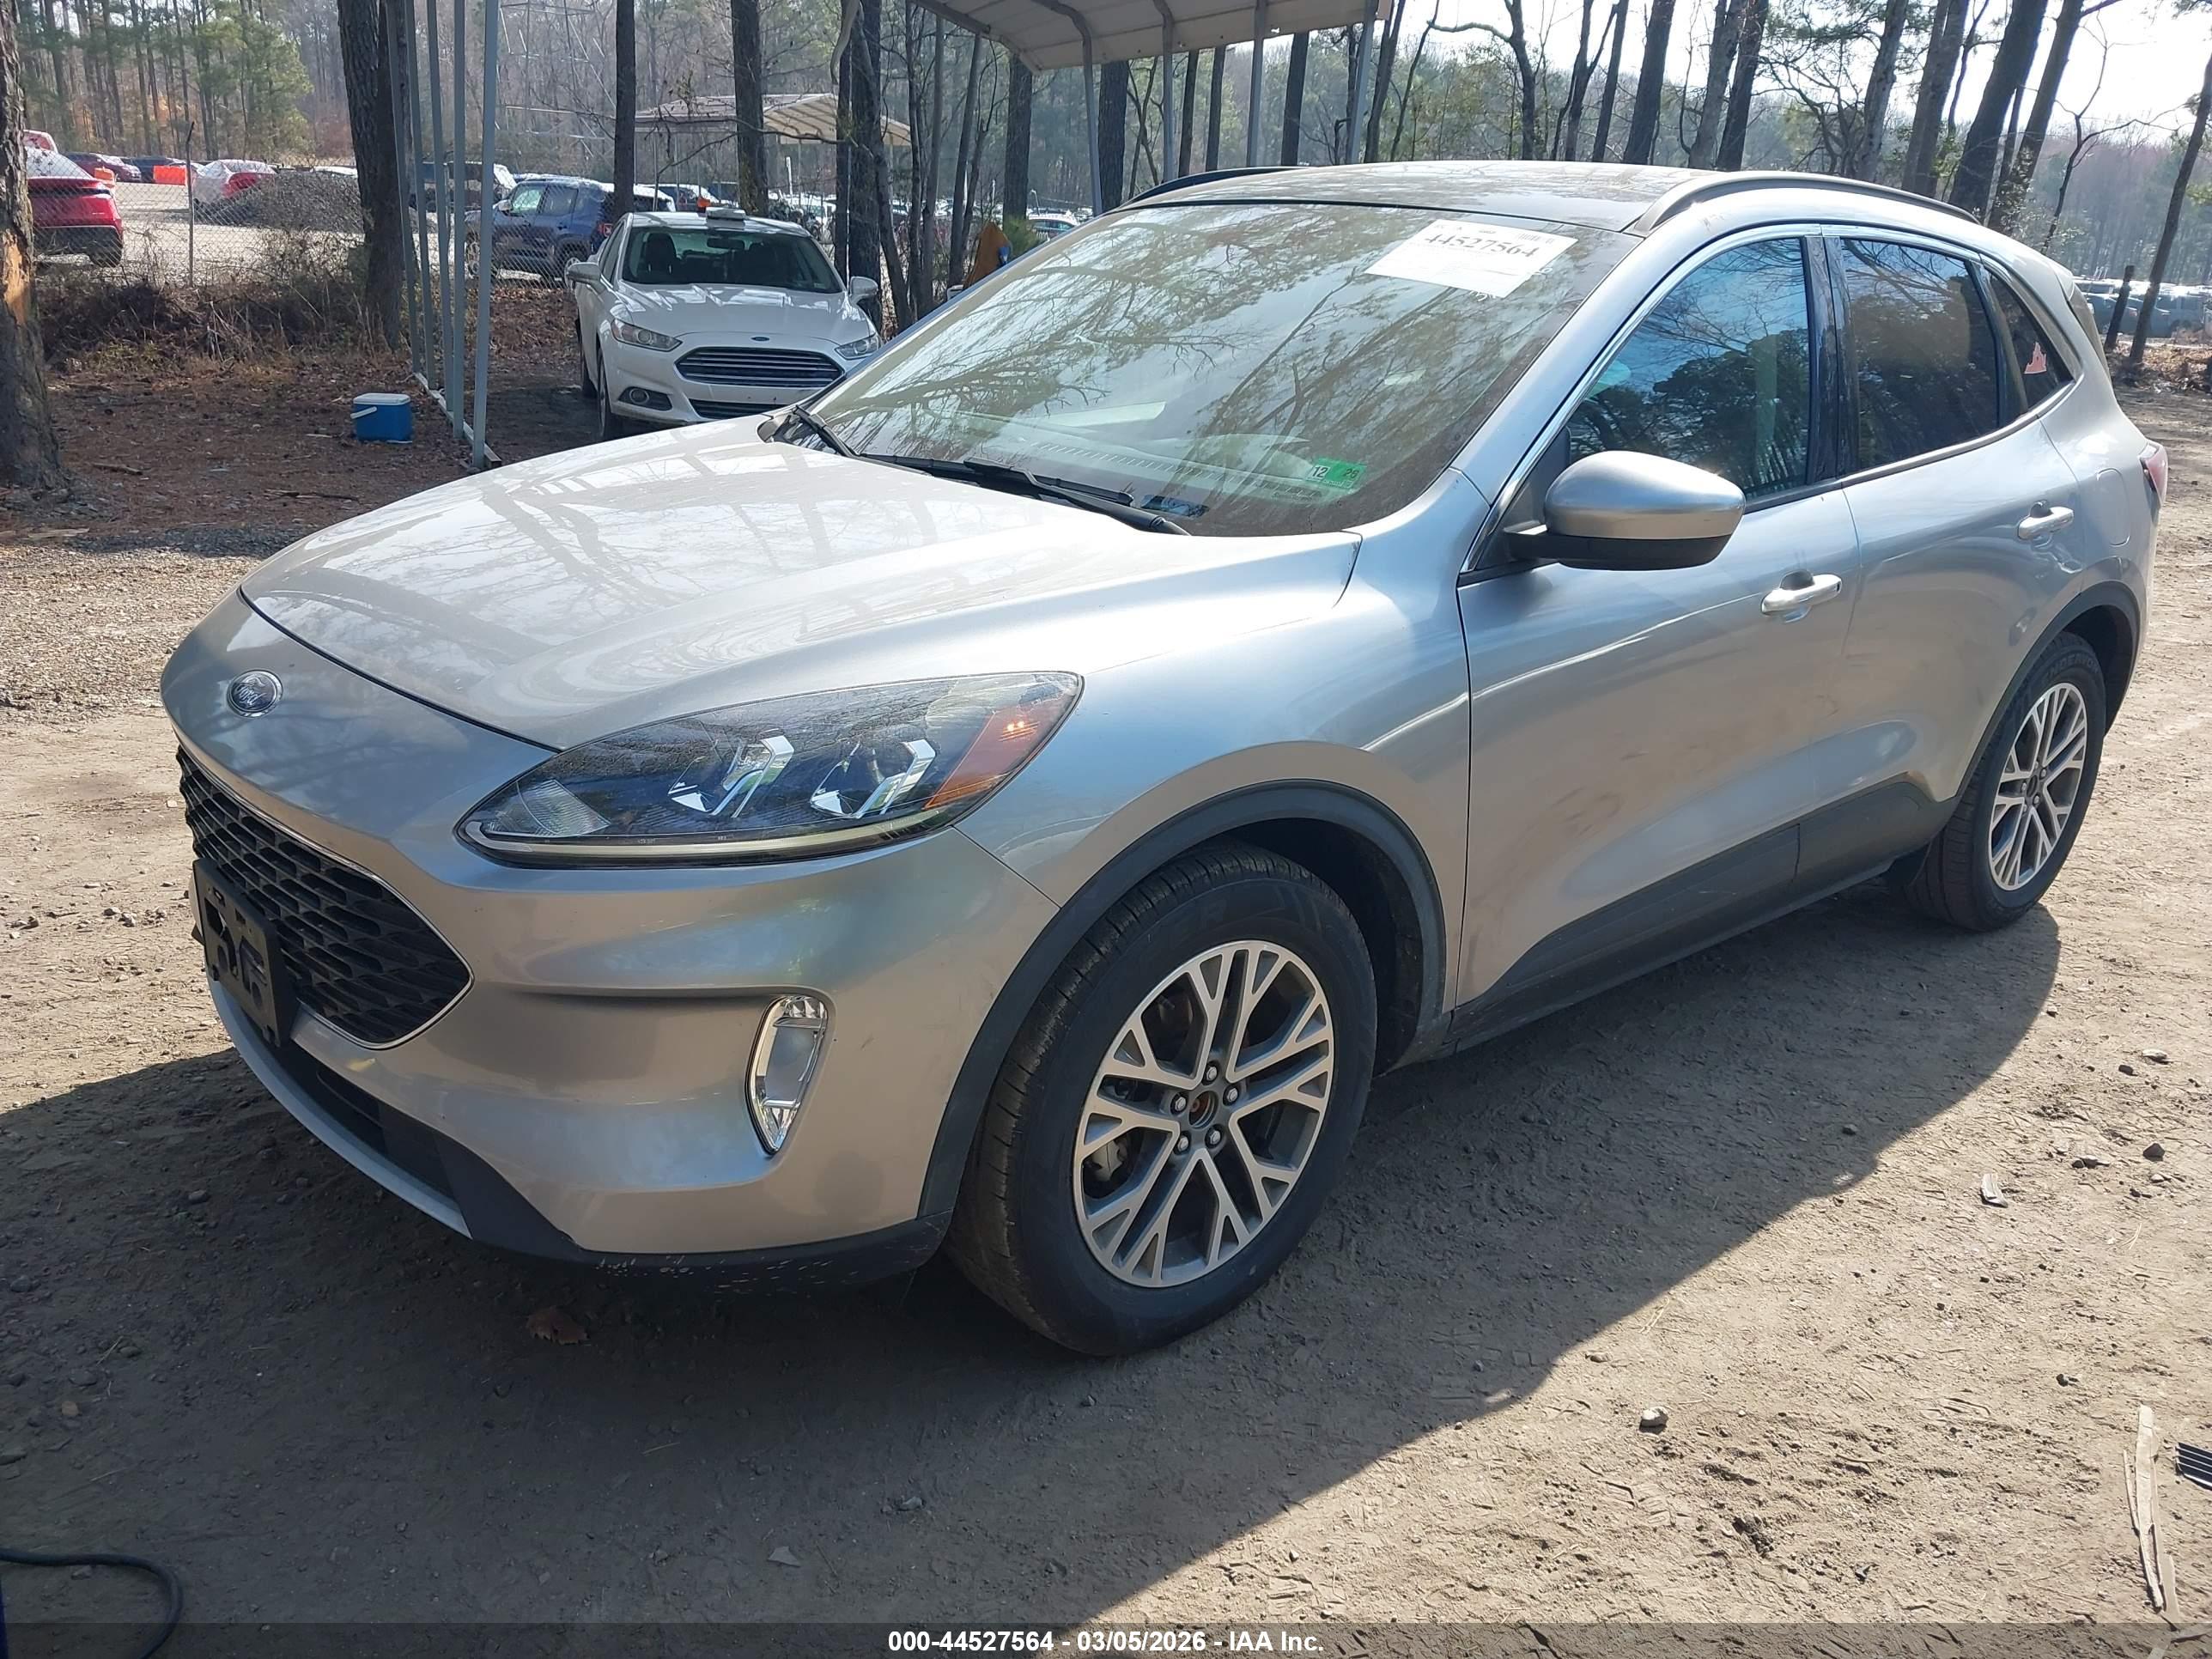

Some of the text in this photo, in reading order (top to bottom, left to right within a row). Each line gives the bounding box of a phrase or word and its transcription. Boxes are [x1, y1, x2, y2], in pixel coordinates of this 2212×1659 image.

[1425, 233, 1540, 258] 44527564
[1311, 465, 1329, 478] 12
[234, 674, 267, 706] Ford
